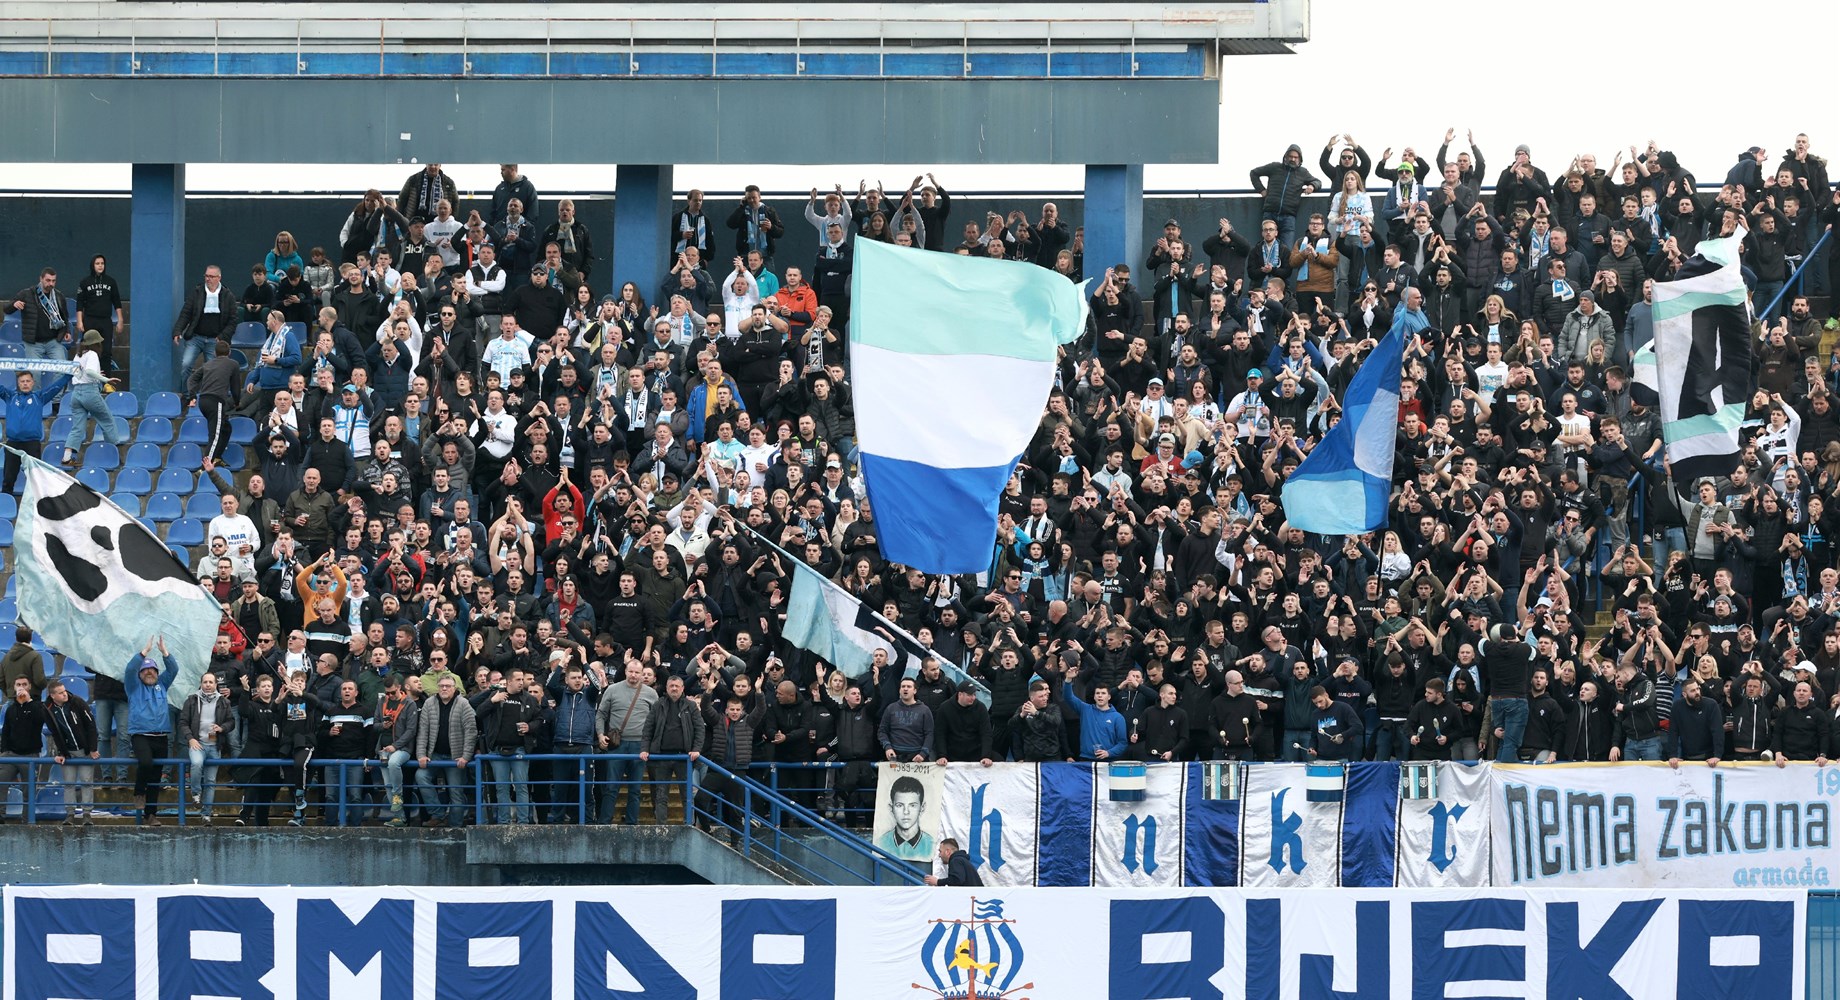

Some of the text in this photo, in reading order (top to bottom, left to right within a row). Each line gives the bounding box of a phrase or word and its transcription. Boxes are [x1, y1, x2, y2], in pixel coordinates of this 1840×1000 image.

[1503, 771, 1831, 885] nema zakona
[1732, 857, 1830, 887] armada
[15, 896, 1794, 1000] ARMADA RIJEKA
